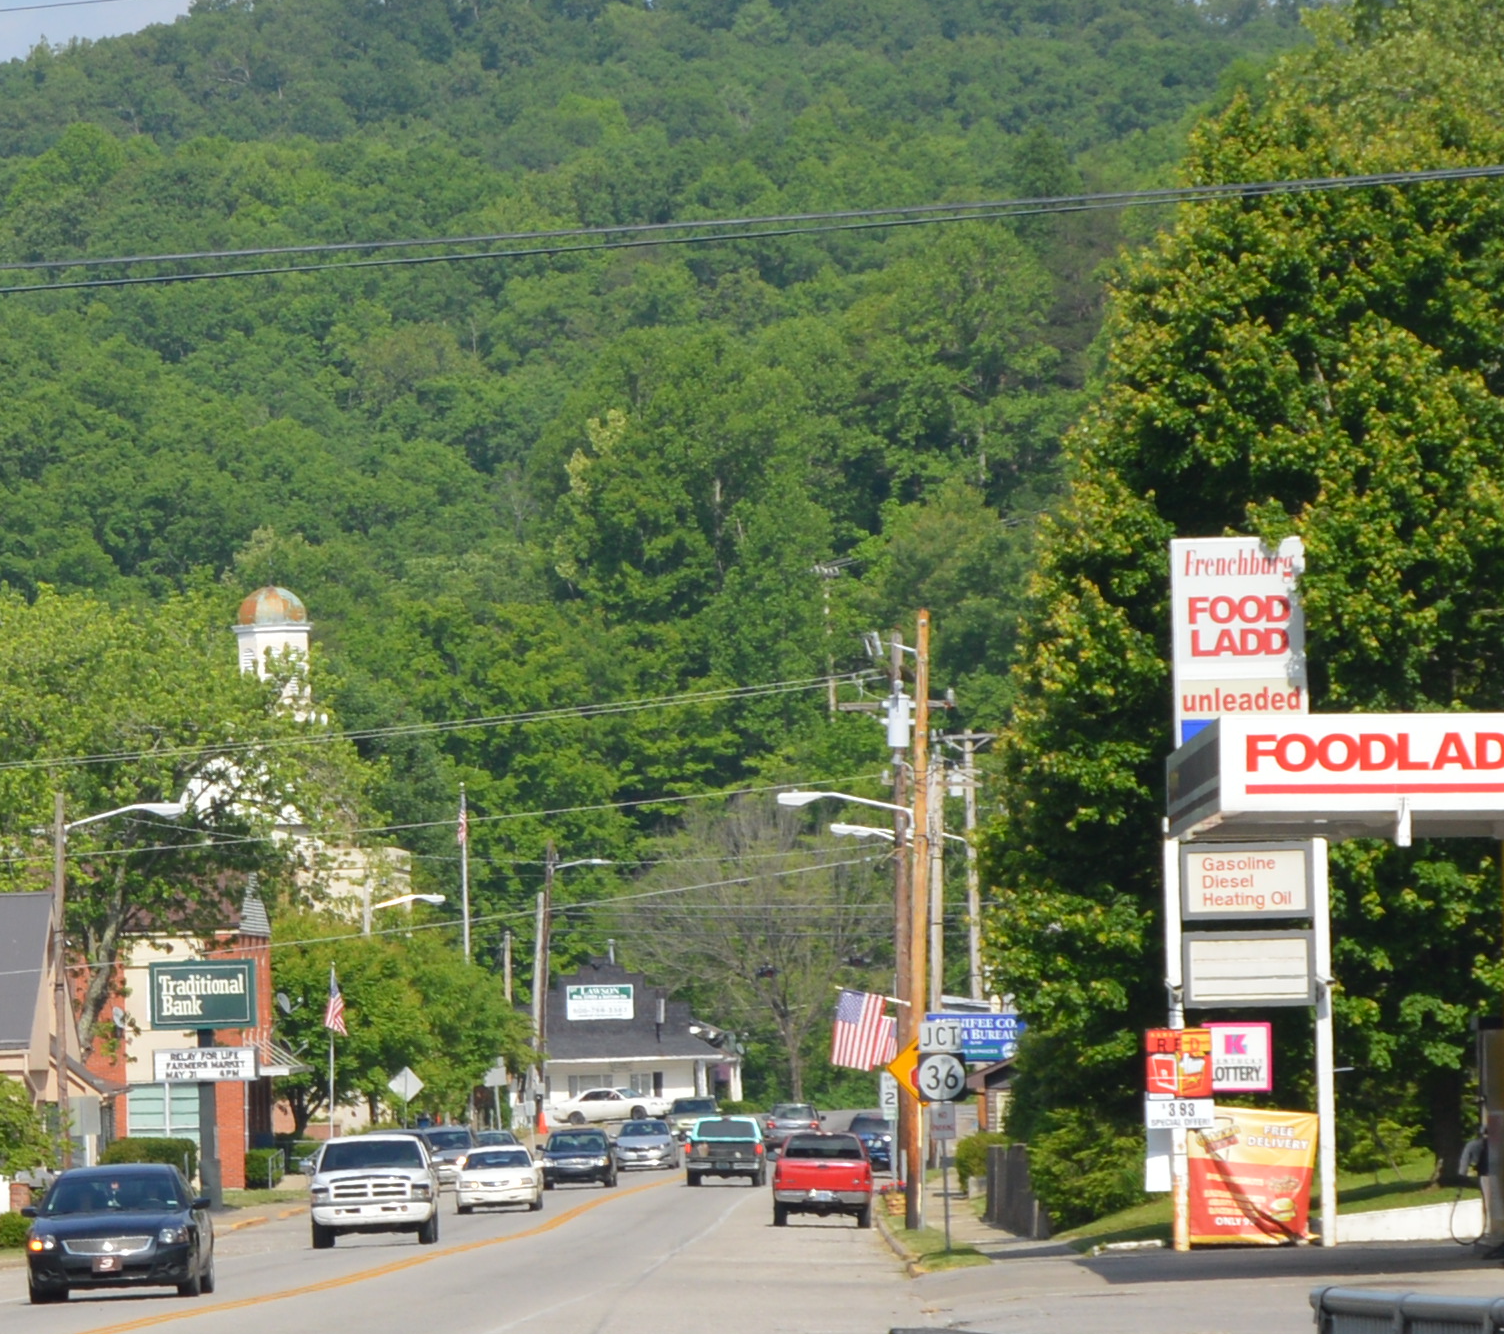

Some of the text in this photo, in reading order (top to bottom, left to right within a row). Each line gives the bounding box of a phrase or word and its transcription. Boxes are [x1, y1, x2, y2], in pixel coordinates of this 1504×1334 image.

[1184, 549, 1294, 584] Frenchburg
[1188, 595, 1291, 624] FOOD
[1191, 628, 1289, 657] LADD
[1183, 686, 1301, 712] unleaded
[1202, 857, 1275, 871] Gasoline
[1202, 875, 1254, 889] Diesel
[1203, 891, 1291, 909] Heating Oil
[158, 974, 245, 995] Traditional
[161, 995, 203, 1016] Bank
[923, 1026, 958, 1046] JCT
[170, 1051, 238, 1061] RELAY FOR LIFE
[166, 1060, 245, 1070] FARMERS MARKET
[166, 1071, 184, 1079] MAY
[926, 1065, 959, 1090] 36
[885, 1092, 895, 1105] 2
[1264, 1126, 1294, 1137] FREE
[1247, 1137, 1309, 1150] DELIVERY
[1215, 1217, 1241, 1226] ONLY
